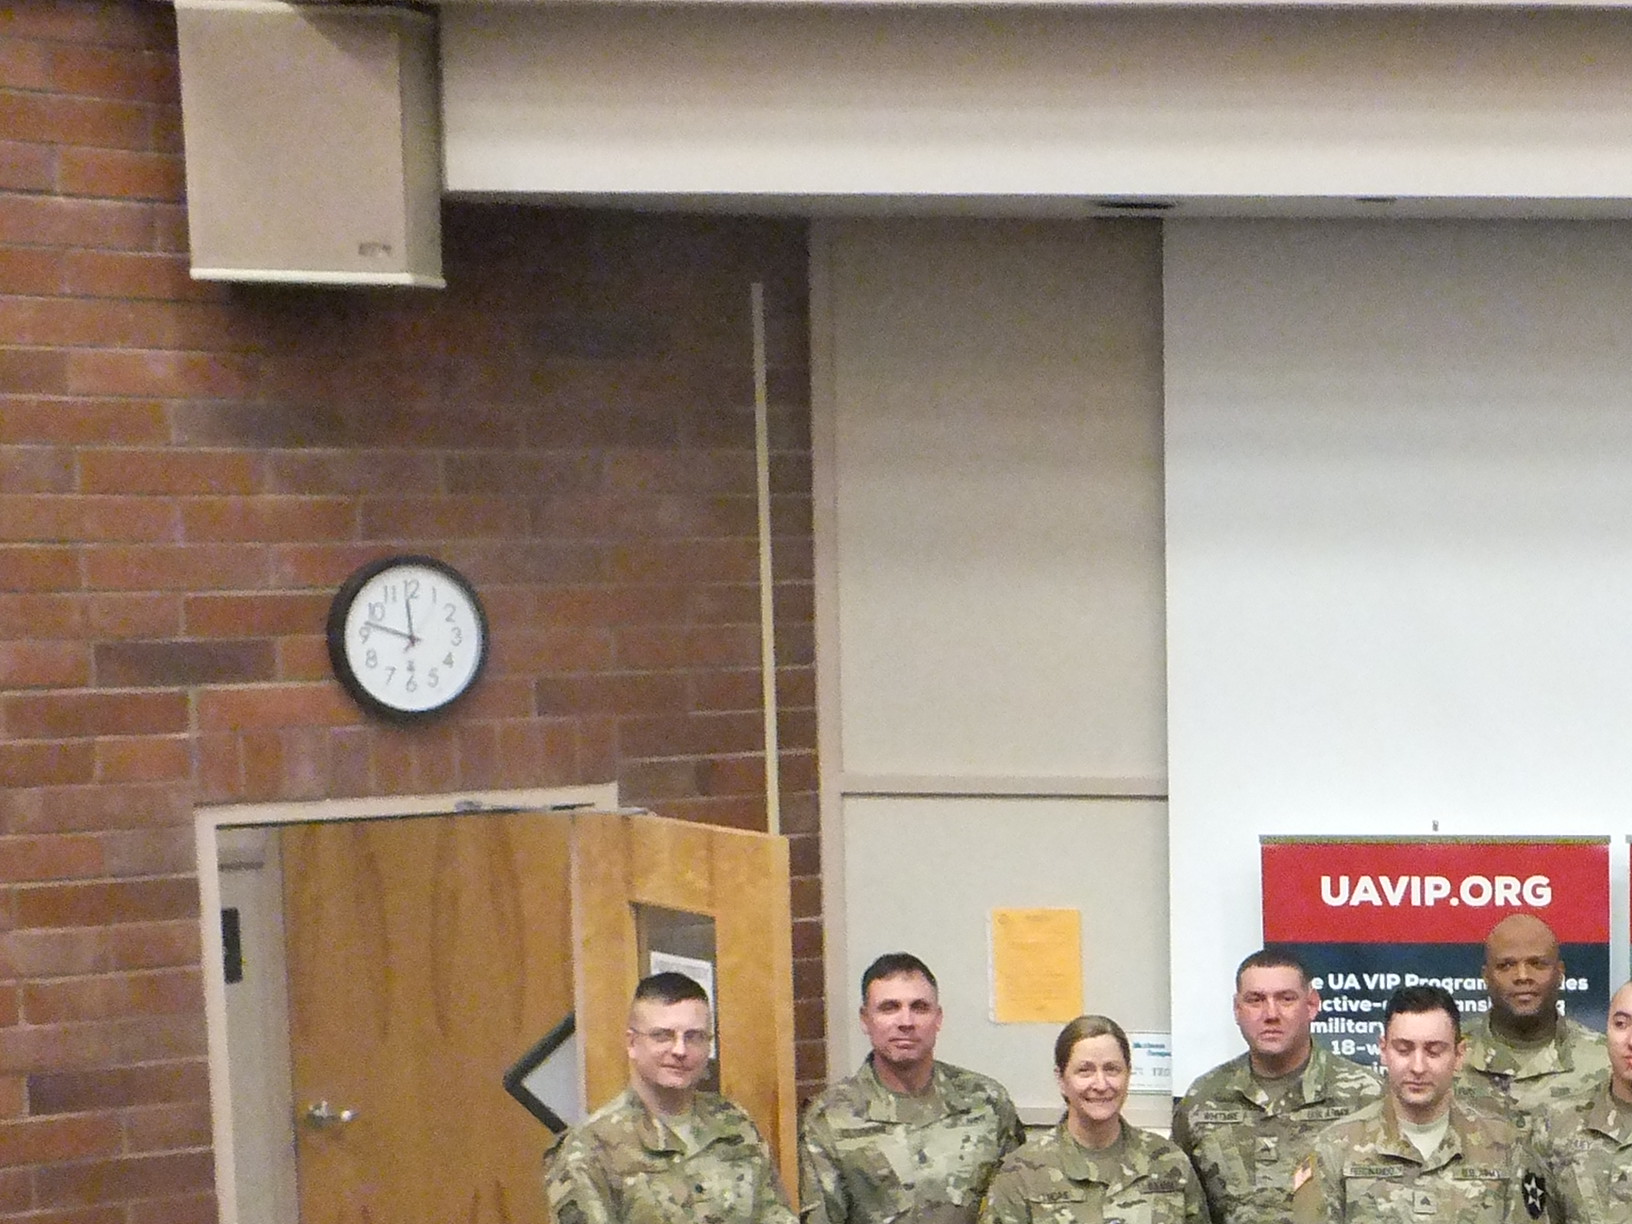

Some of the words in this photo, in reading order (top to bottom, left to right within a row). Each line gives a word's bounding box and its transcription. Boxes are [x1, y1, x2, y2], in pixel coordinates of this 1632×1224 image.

[384, 585, 397, 603] 11
[403, 579, 419, 599] 12
[368, 602, 385, 621] 10
[444, 603, 456, 623] 2
[359, 626, 371, 645] 9
[451, 626, 462, 646] 3
[365, 650, 378, 668] 8
[442, 651, 454, 668] 4
[385, 666, 397, 685] 7
[405, 674, 418, 692] 6
[427, 667, 439, 688] 5
[1320, 875, 1552, 906] UAVIP.ORG
[1328, 973, 1361, 990] UA
[1362, 973, 1401, 990] VIP
[1331, 1039, 1380, 1055] 18-w
